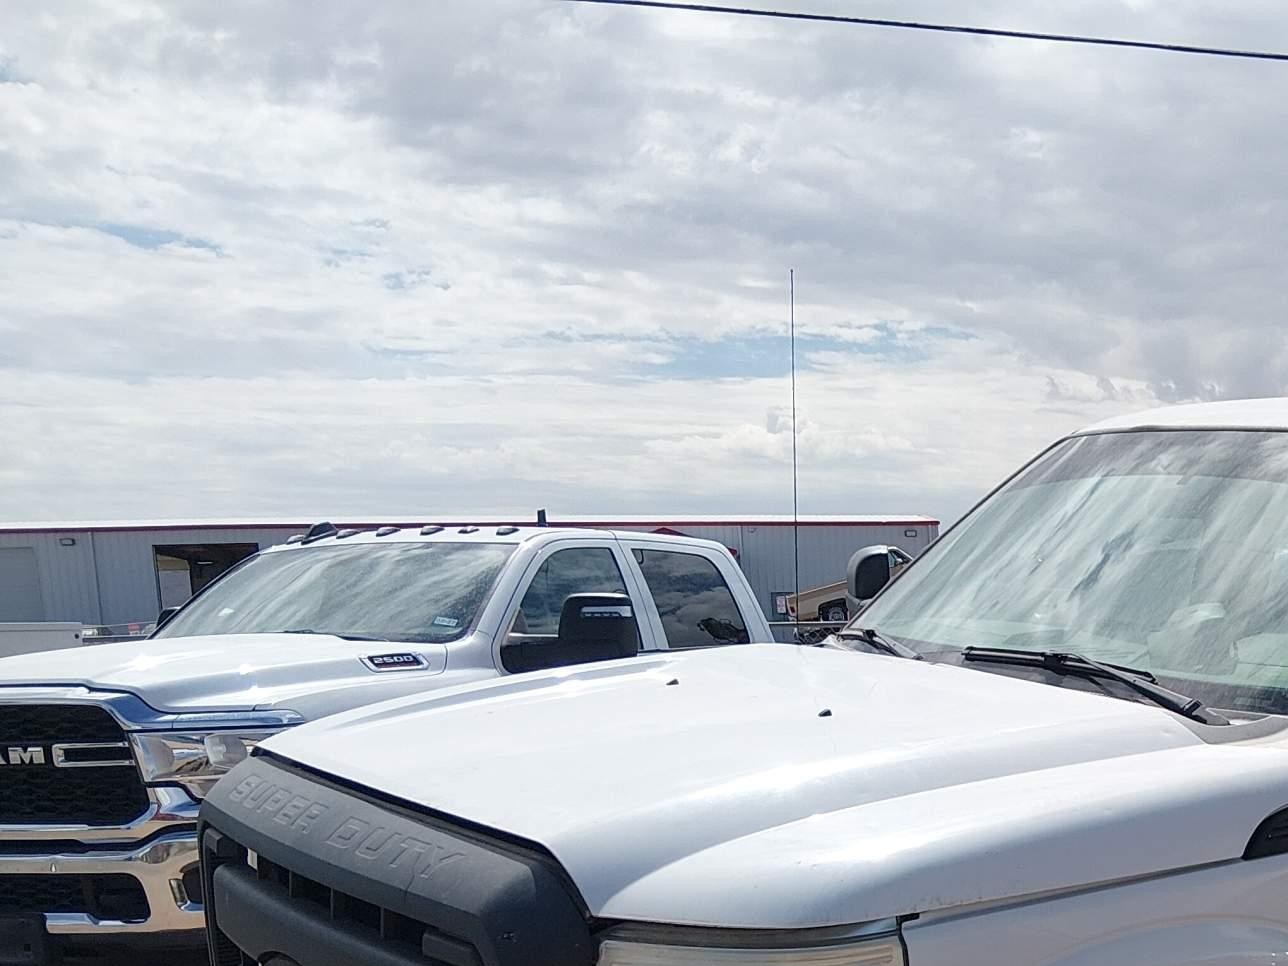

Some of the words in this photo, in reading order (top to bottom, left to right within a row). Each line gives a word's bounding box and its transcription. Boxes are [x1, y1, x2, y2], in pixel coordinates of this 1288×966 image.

[372, 655, 414, 664] 2500
[229, 774, 329, 835] SUPER
[325, 815, 466, 879] DUTY
